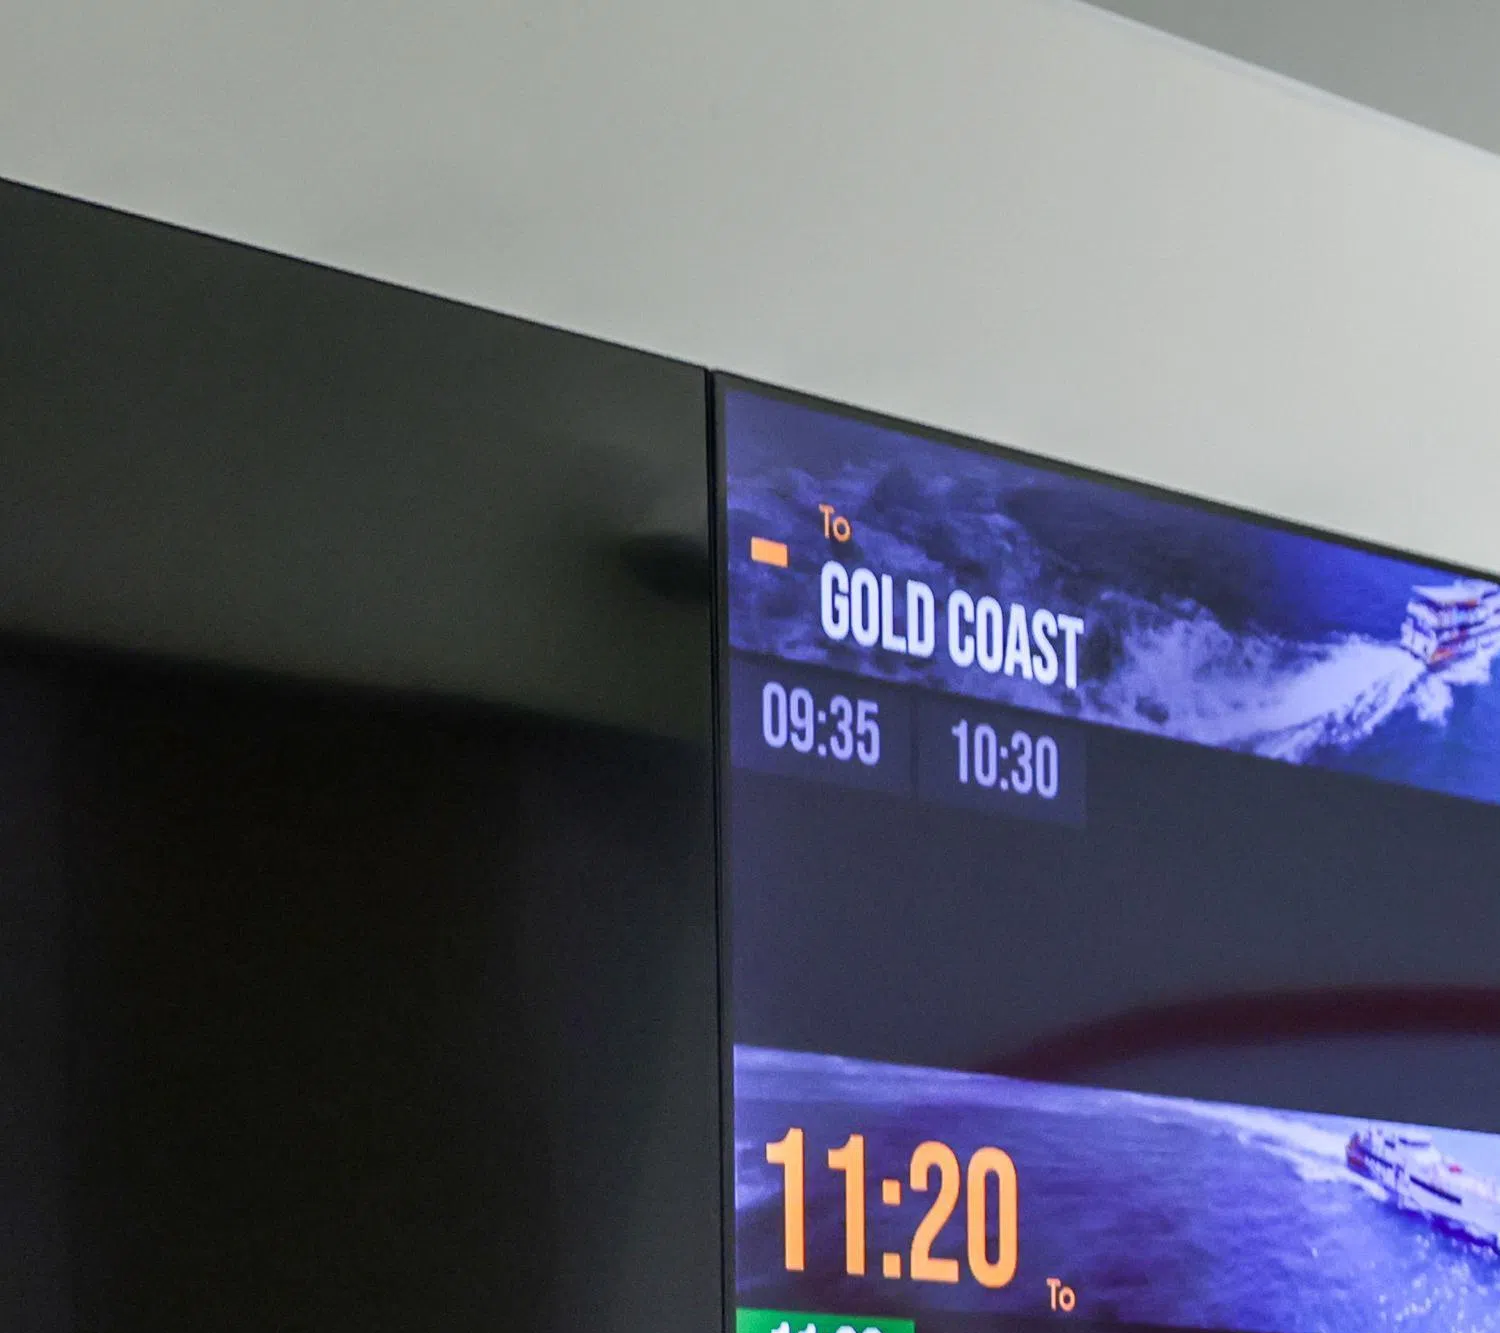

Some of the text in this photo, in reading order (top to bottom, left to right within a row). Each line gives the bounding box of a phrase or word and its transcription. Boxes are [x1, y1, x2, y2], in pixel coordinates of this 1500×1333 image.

[819, 503, 852, 544] To
[821, 561, 1084, 690] GOLD COAST
[763, 682, 1060, 798] 09:35 10:30
[766, 1128, 1019, 1289] 11:20
[1047, 1278, 1077, 1312] To
